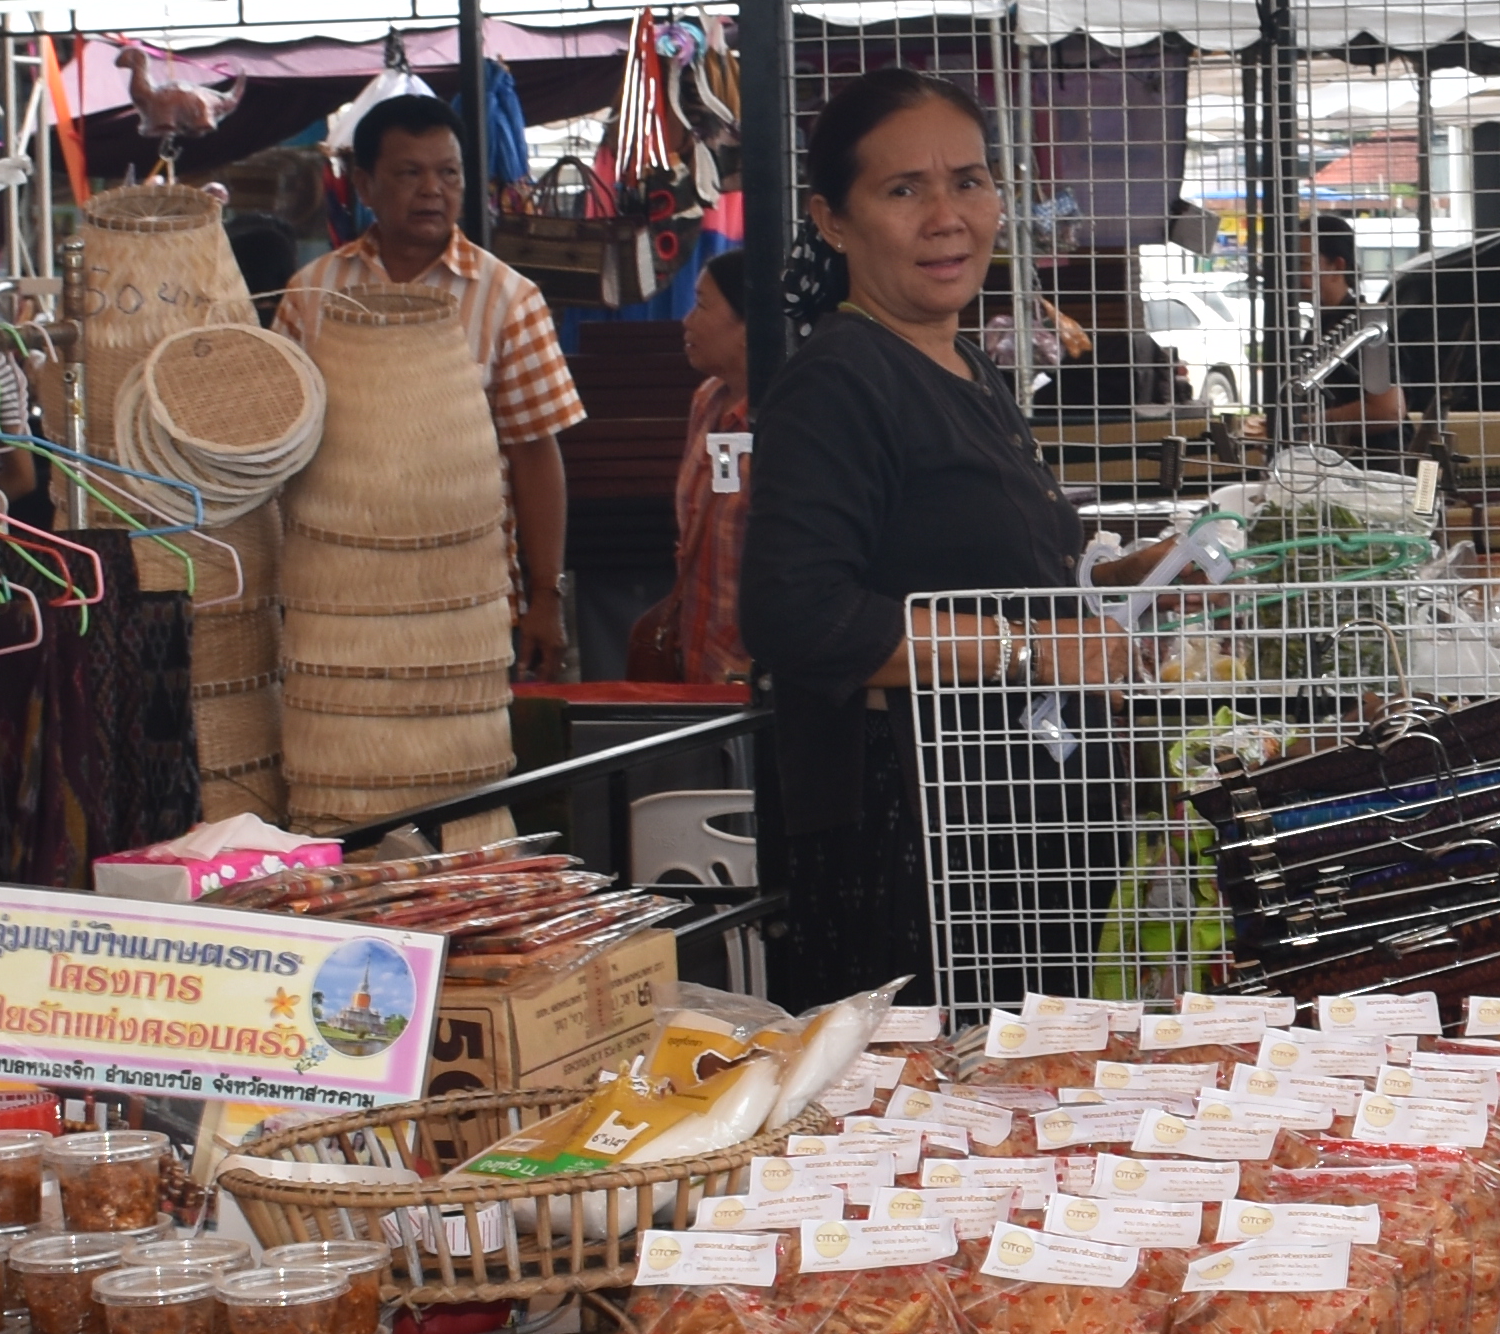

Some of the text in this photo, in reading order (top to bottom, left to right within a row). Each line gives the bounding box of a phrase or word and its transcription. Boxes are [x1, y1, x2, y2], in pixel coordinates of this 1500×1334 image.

[49, 954, 203, 1004] โครงการ
[105, 1063, 202, 1092] อำเภอบรบือ
[212, 1072, 375, 1108] จังหวัดมหาสารคาม
[1365, 1105, 1393, 1115] OTOP
[1156, 1123, 1185, 1134] OTOP
[763, 1169, 790, 1178] OTOP
[1115, 1170, 1144, 1179] OTOP
[929, 1175, 958, 1183] OTOP
[891, 1202, 921, 1211] OTOP
[1066, 1209, 1097, 1219] OTOP
[1240, 1216, 1271, 1225] OTOP
[816, 1233, 847, 1242] OTOP
[1001, 1241, 1032, 1254] OTOP
[649, 1248, 680, 1257] OTOP
